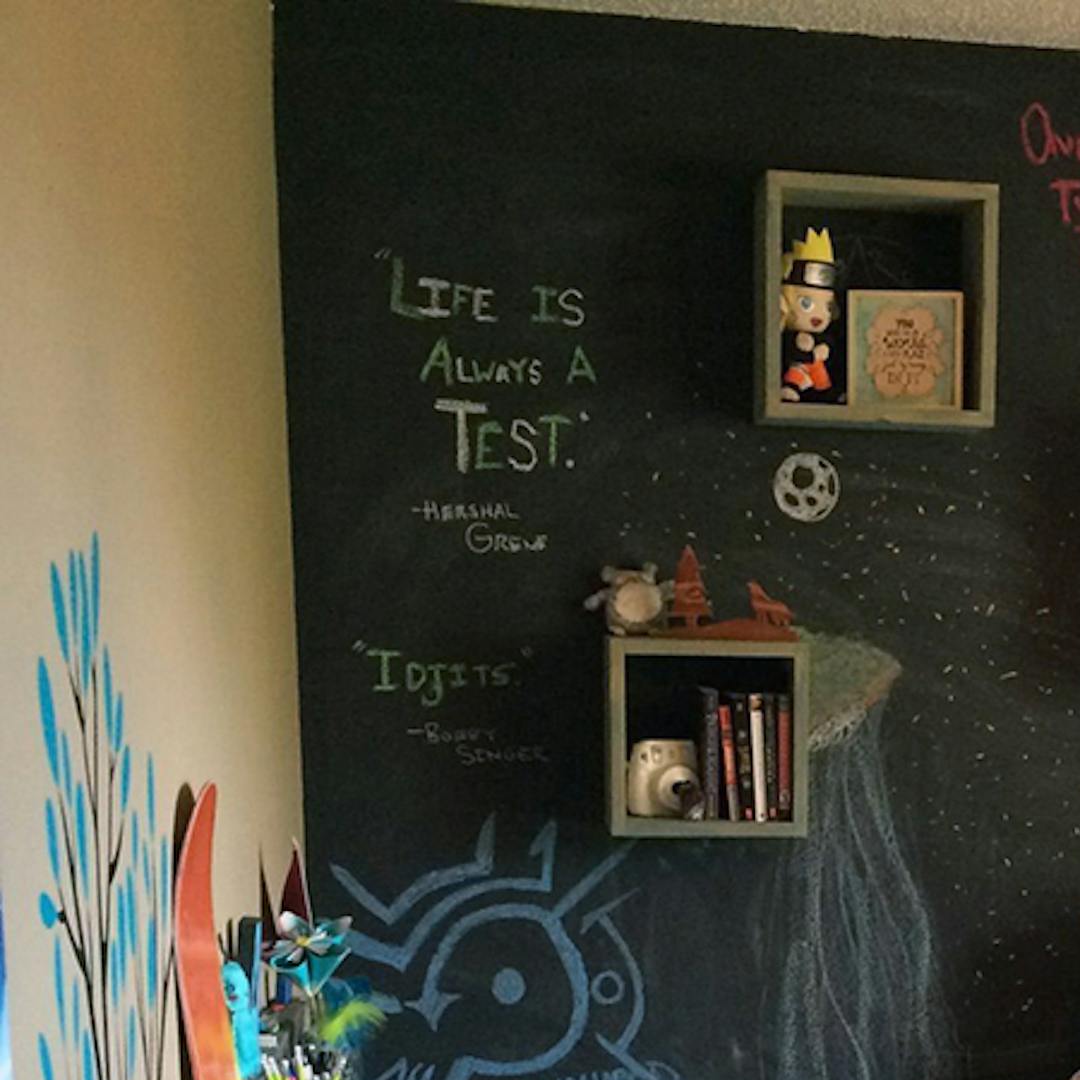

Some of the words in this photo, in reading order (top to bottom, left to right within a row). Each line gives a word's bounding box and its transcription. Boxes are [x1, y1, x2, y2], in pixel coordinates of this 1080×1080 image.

[530, 285, 585, 327] IS
[420, 336, 543, 386] ALWAYS
[567, 345, 597, 384] A
